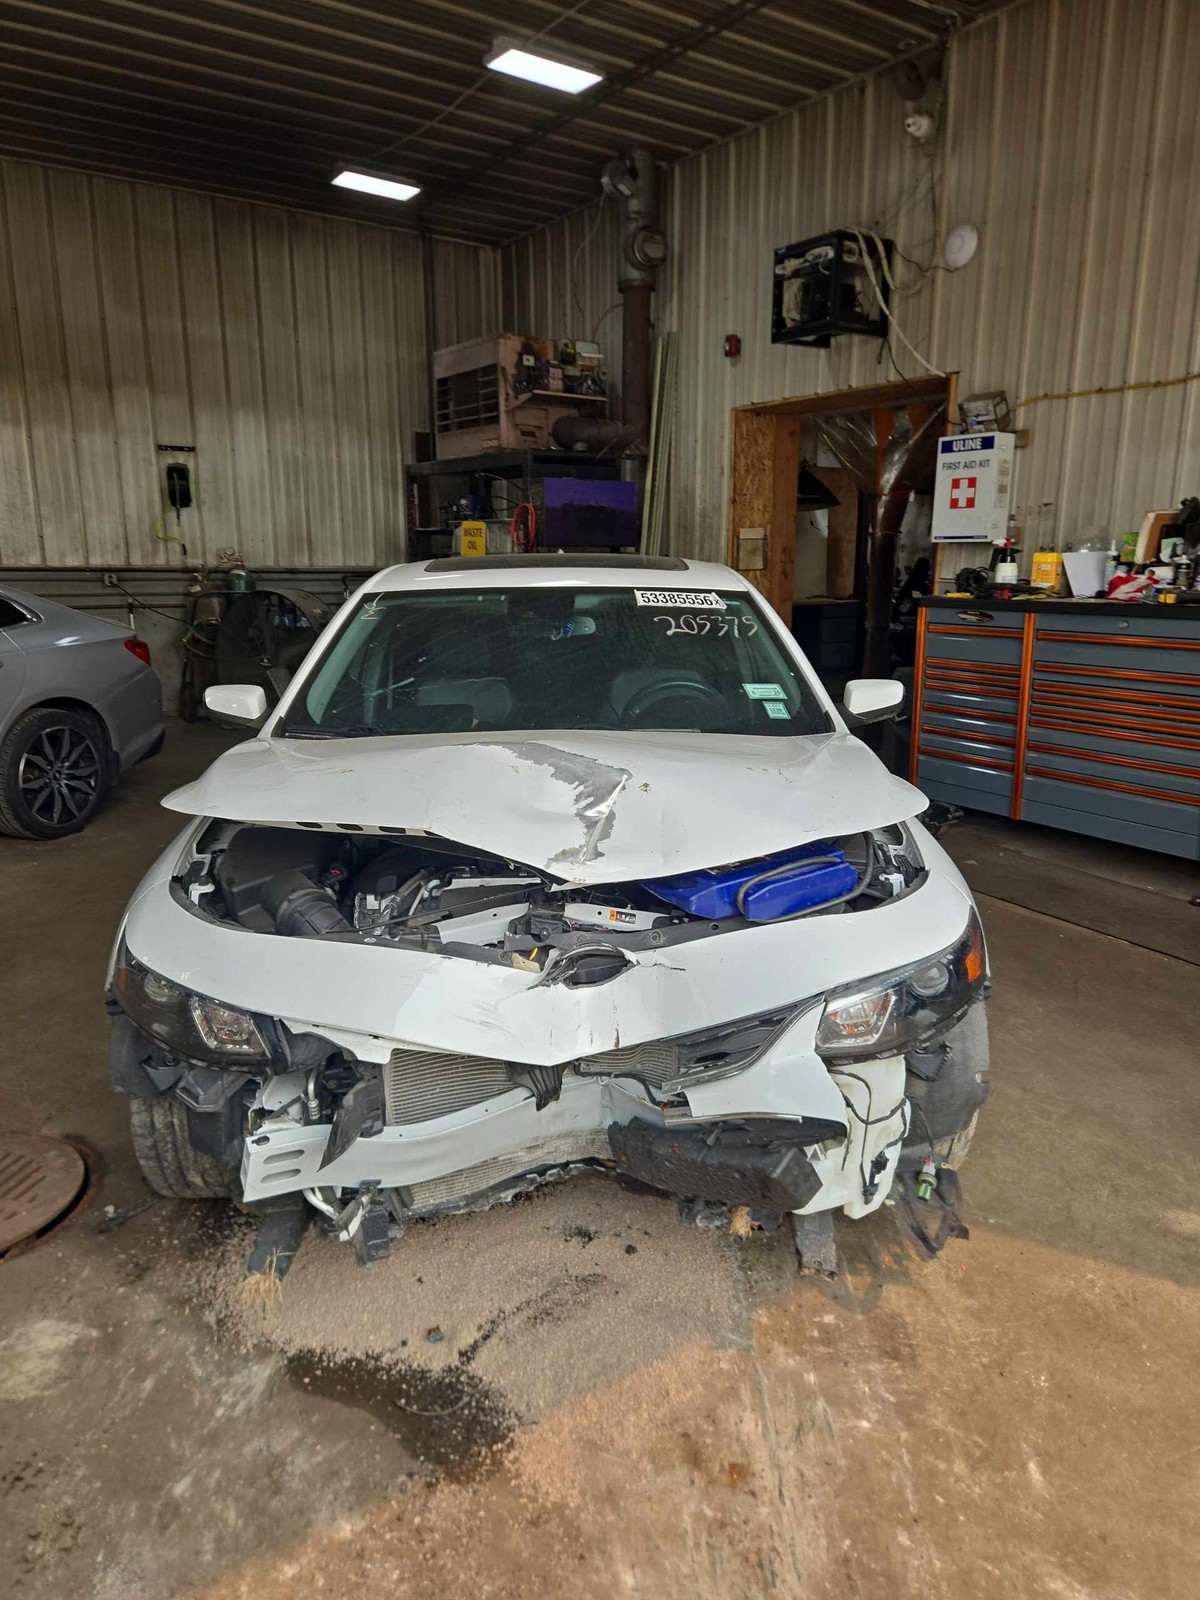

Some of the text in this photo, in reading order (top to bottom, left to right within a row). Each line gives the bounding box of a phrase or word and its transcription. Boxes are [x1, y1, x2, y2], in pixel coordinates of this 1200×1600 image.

[952, 438, 982, 451] ULINE
[942, 459, 991, 471] FIRST AID KIT
[464, 527, 483, 538] WASTE
[467, 540, 478, 550] OIL
